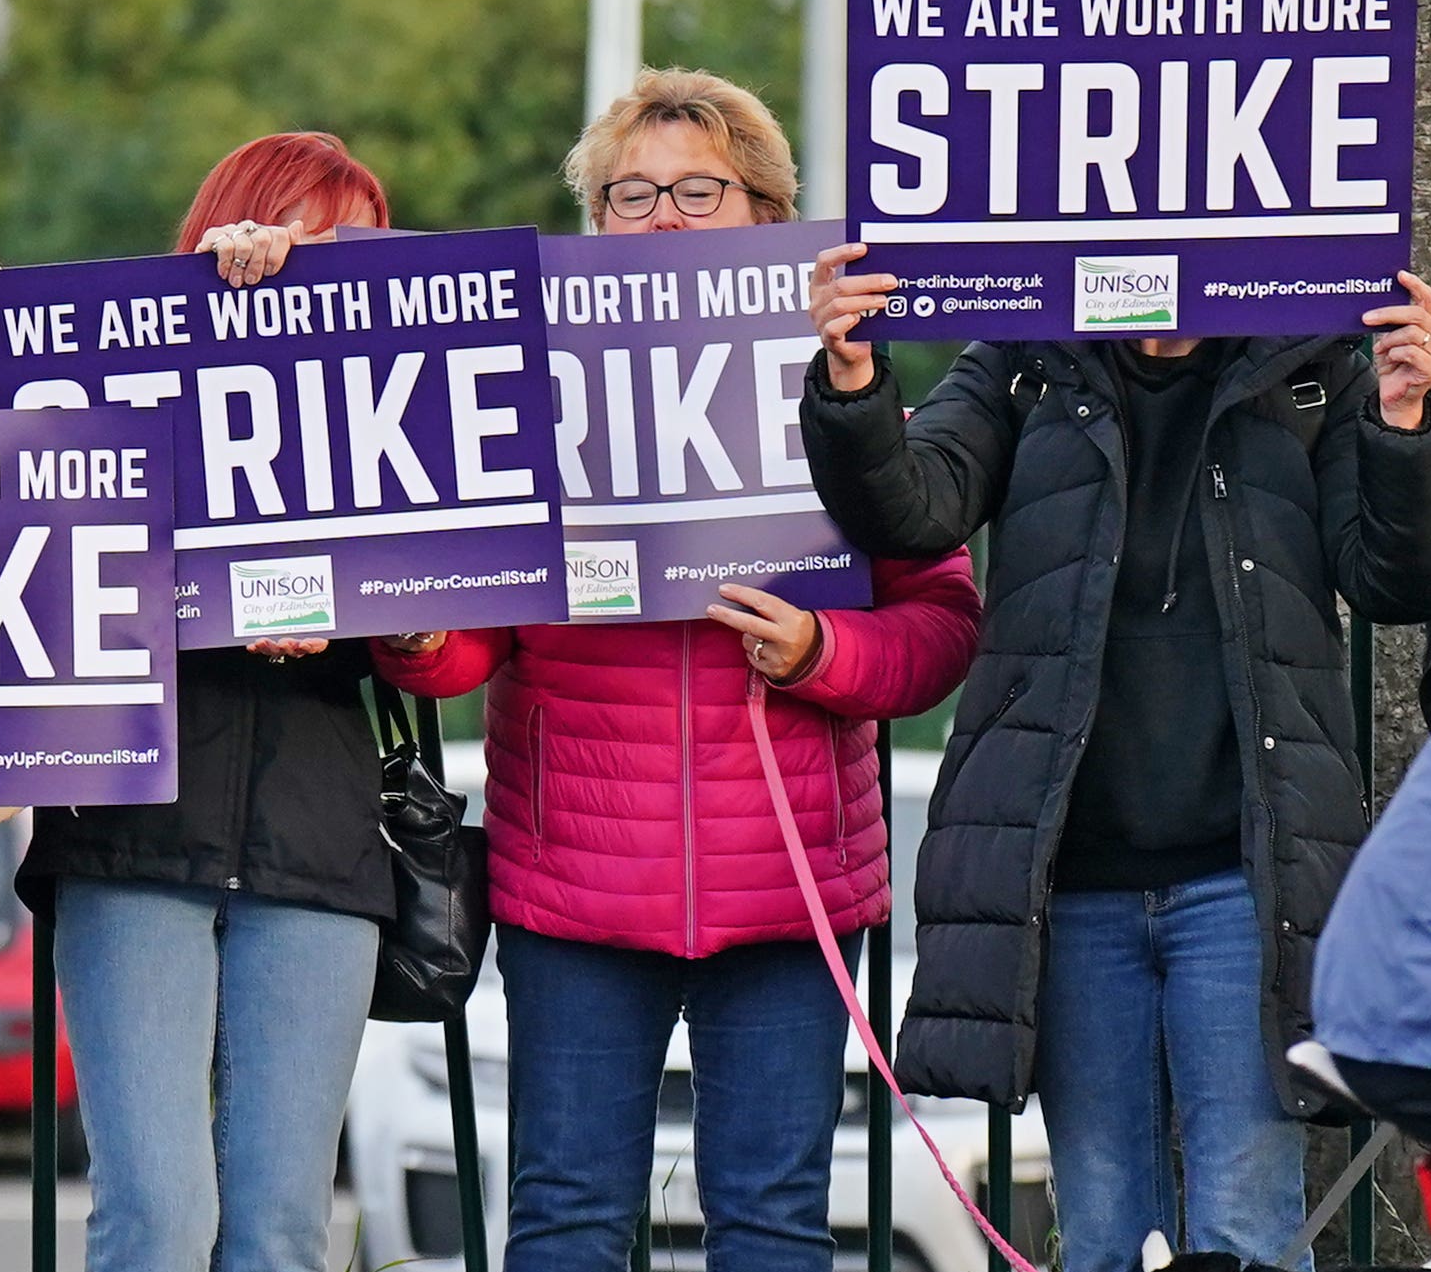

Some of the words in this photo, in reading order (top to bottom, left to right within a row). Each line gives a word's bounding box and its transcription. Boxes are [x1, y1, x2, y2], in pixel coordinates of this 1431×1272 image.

[871, 56, 1389, 215] STRIKE
[898, 274, 1044, 292] n-edinburgh.org.uk
[1085, 275, 1168, 293] UNISON
[1204, 278, 1392, 299] #PayUpForCouncilStaff
[4, 304, 78, 356] WE
[99, 295, 190, 349] ARE
[208, 281, 371, 340] WORTH
[388, 270, 519, 326] MORE
[942, 296, 1042, 313] @unisonedin
[1086, 299, 1106, 309] City
[1109, 299, 1121, 311] of
[1122, 298, 1174, 309] Edinburgh
[548, 336, 823, 497] RIKE
[19, 449, 147, 499] MORE
[566, 558, 630, 580] NISON
[665, 554, 850, 581] #PayUpForCouncilStaff
[241, 576, 323, 598] UNISON
[360, 568, 547, 596] #PayUpForCouncilStaff
